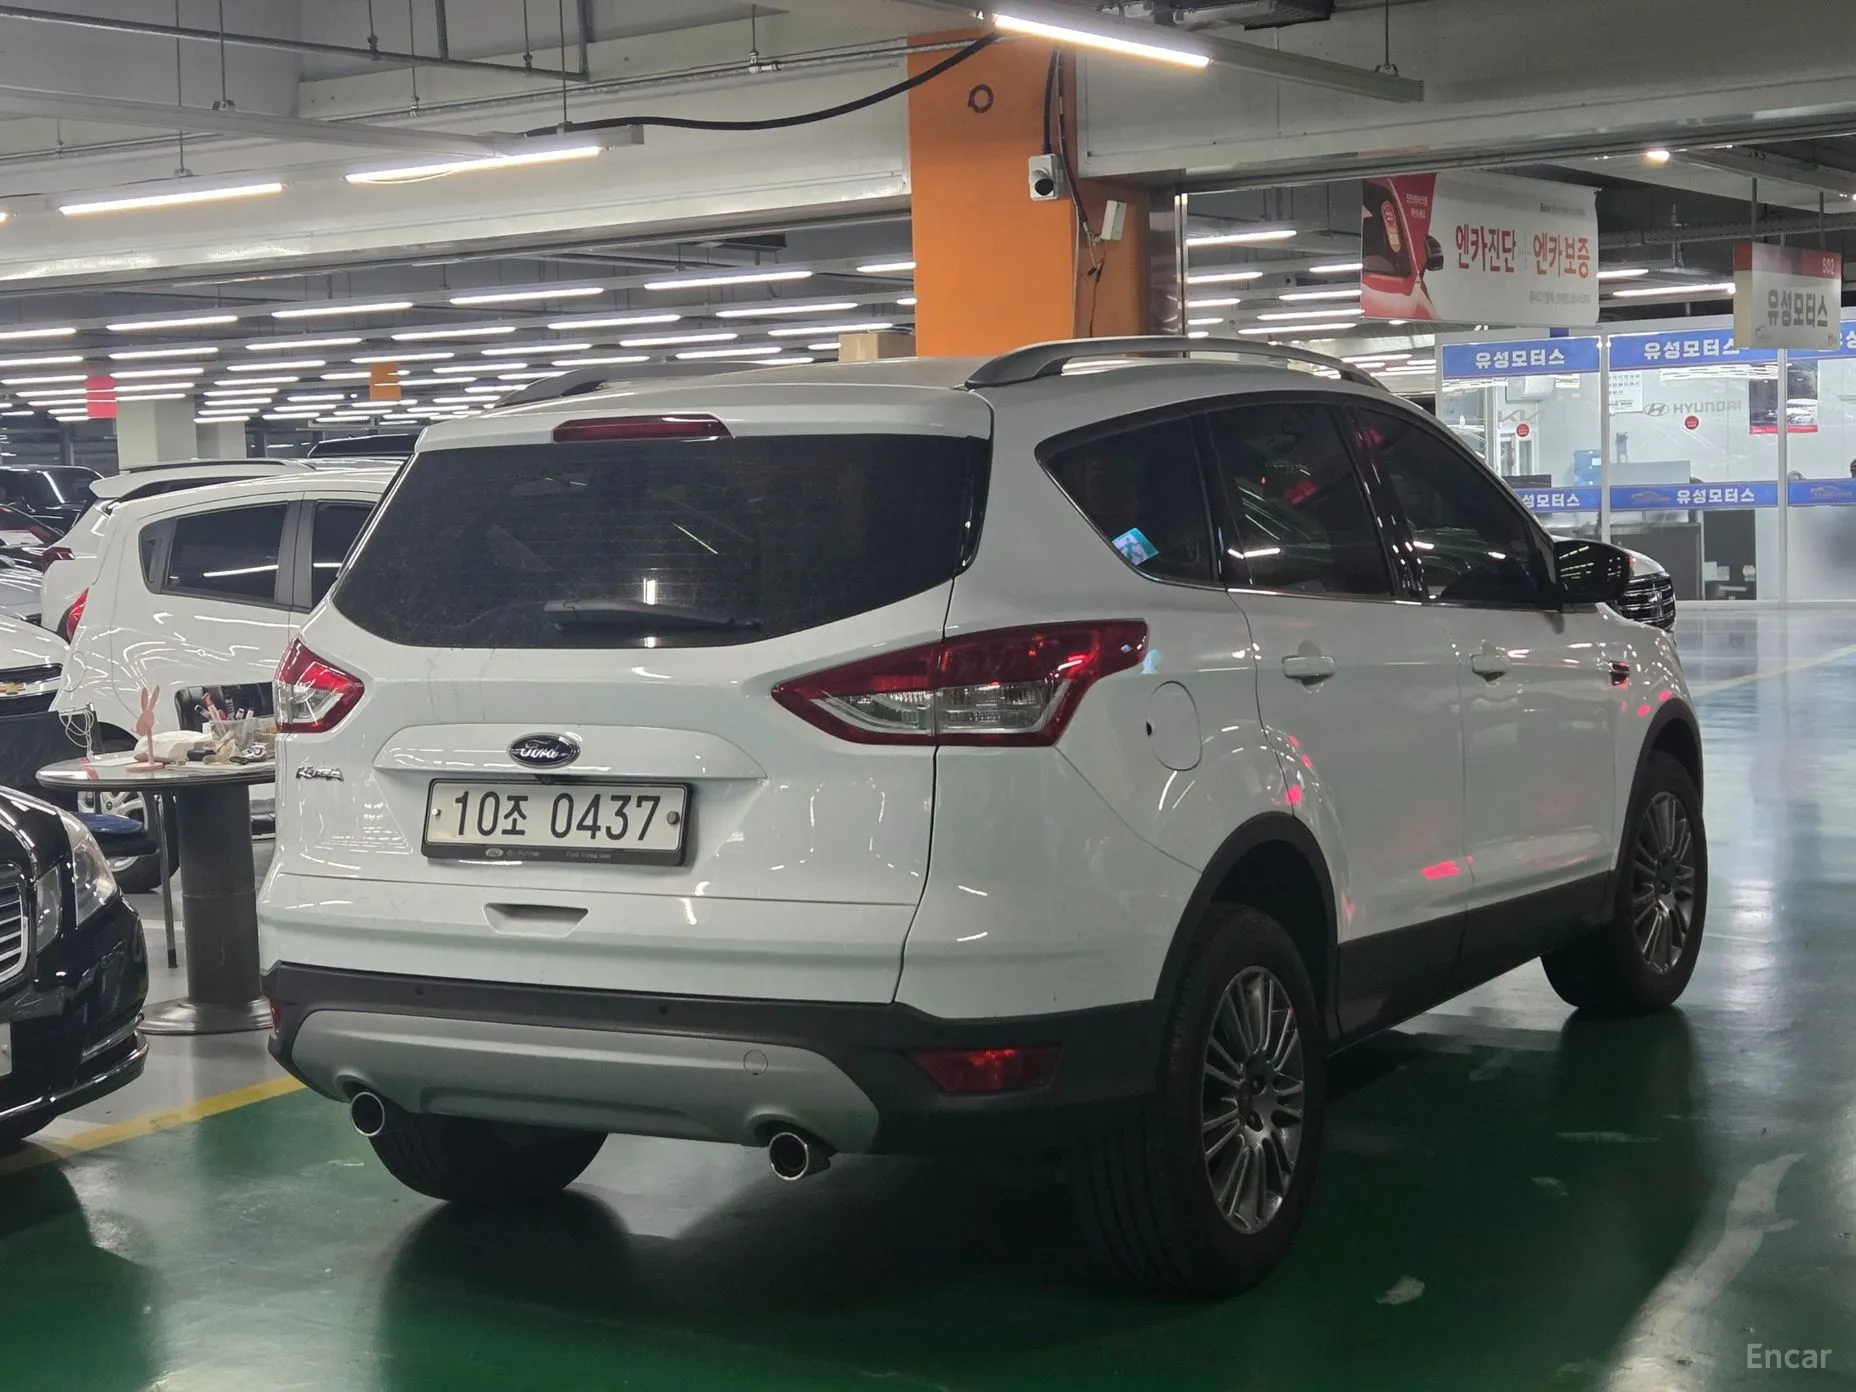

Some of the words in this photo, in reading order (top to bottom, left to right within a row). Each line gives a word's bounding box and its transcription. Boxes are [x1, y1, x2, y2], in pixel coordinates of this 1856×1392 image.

[1456, 224, 1516, 273] 엔카진단
[1533, 231, 1590, 279] 엔카보증
[1767, 289, 1828, 328] 유성모터스
[1475, 348, 1565, 369] 유성모터스
[1673, 401, 1742, 414] HYUNDAI
[1676, 488, 1755, 504] 유성모터스
[515, 739, 562, 758] Ford
[454, 790, 529, 836] 10조
[550, 792, 661, 841] 0437
